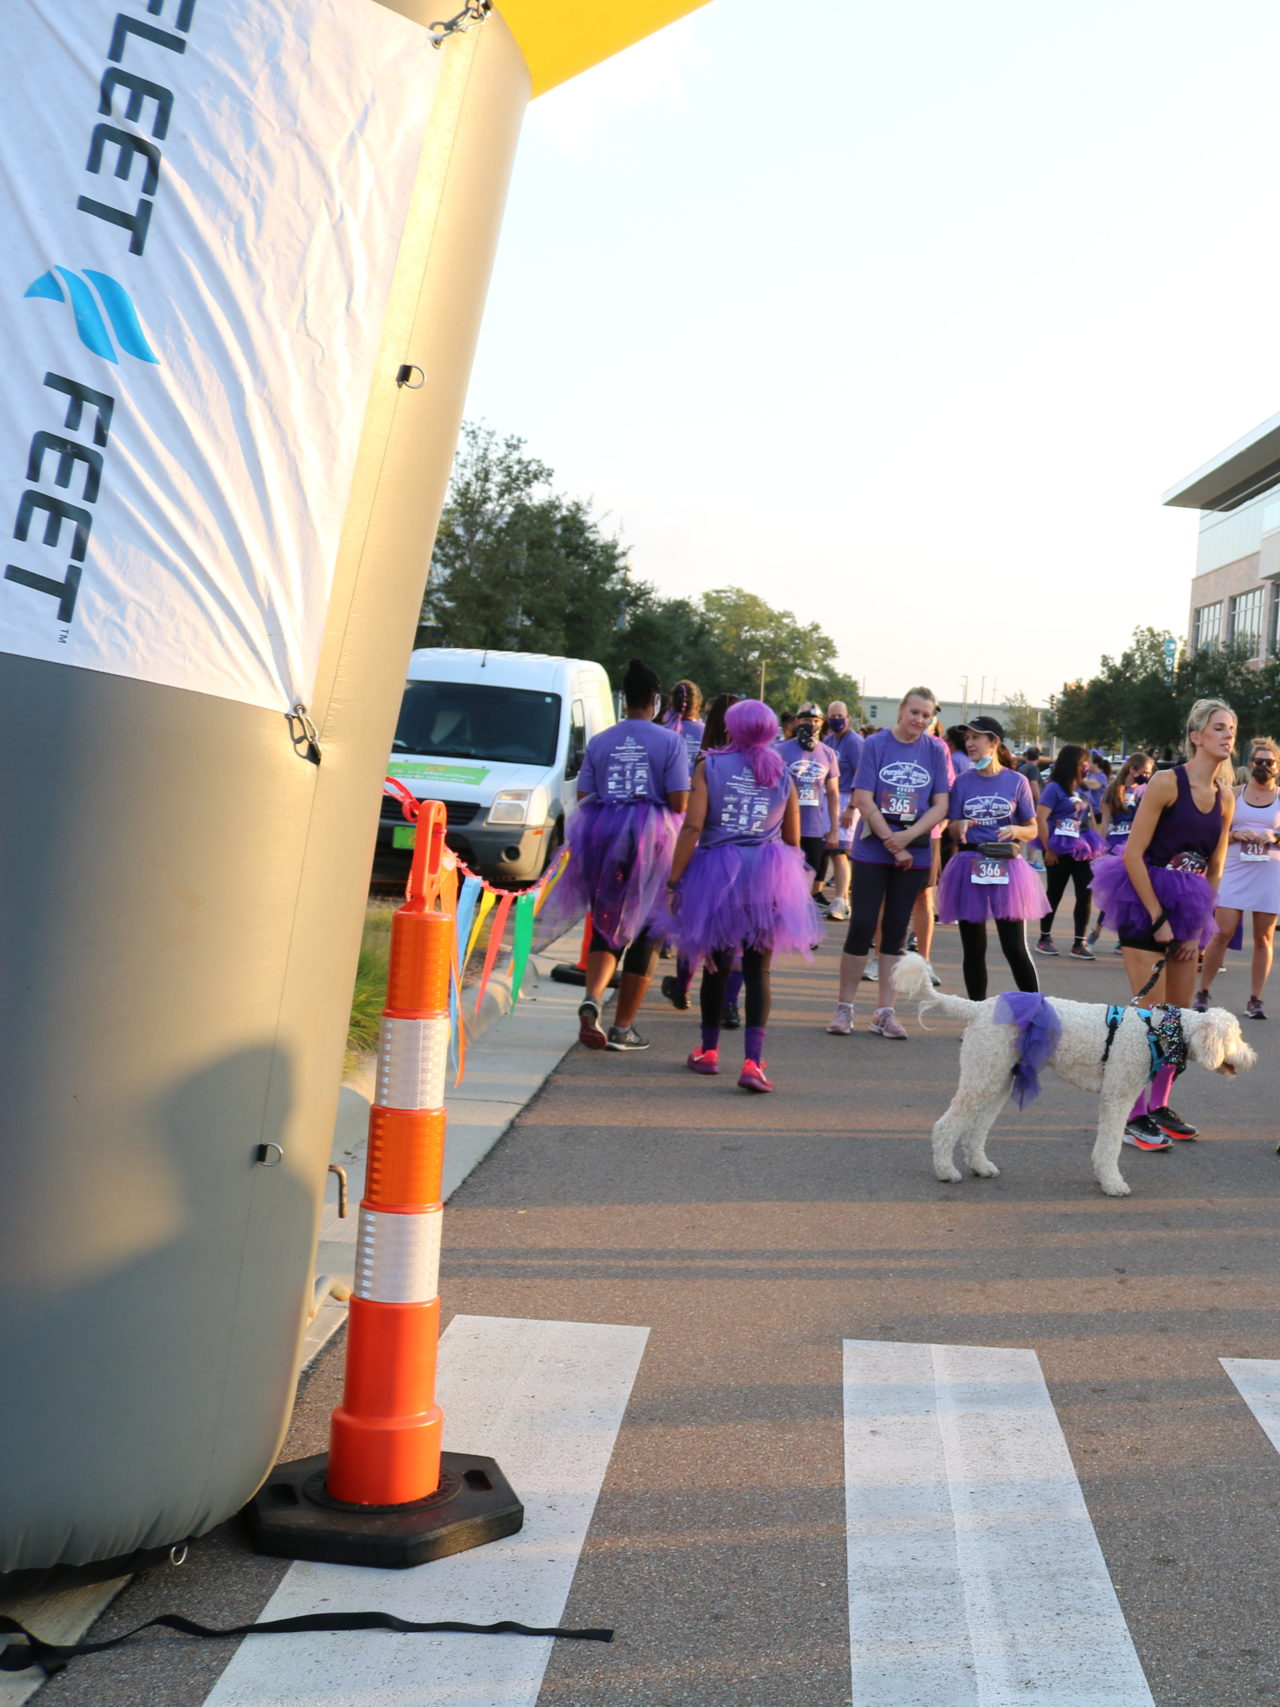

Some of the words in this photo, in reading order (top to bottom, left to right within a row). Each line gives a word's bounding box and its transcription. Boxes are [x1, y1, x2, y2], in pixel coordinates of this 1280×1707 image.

[4, 372, 115, 623] FEET
[889, 798, 911, 813] 365
[1246, 842, 1265, 855] 219
[979, 863, 1001, 877] 366
